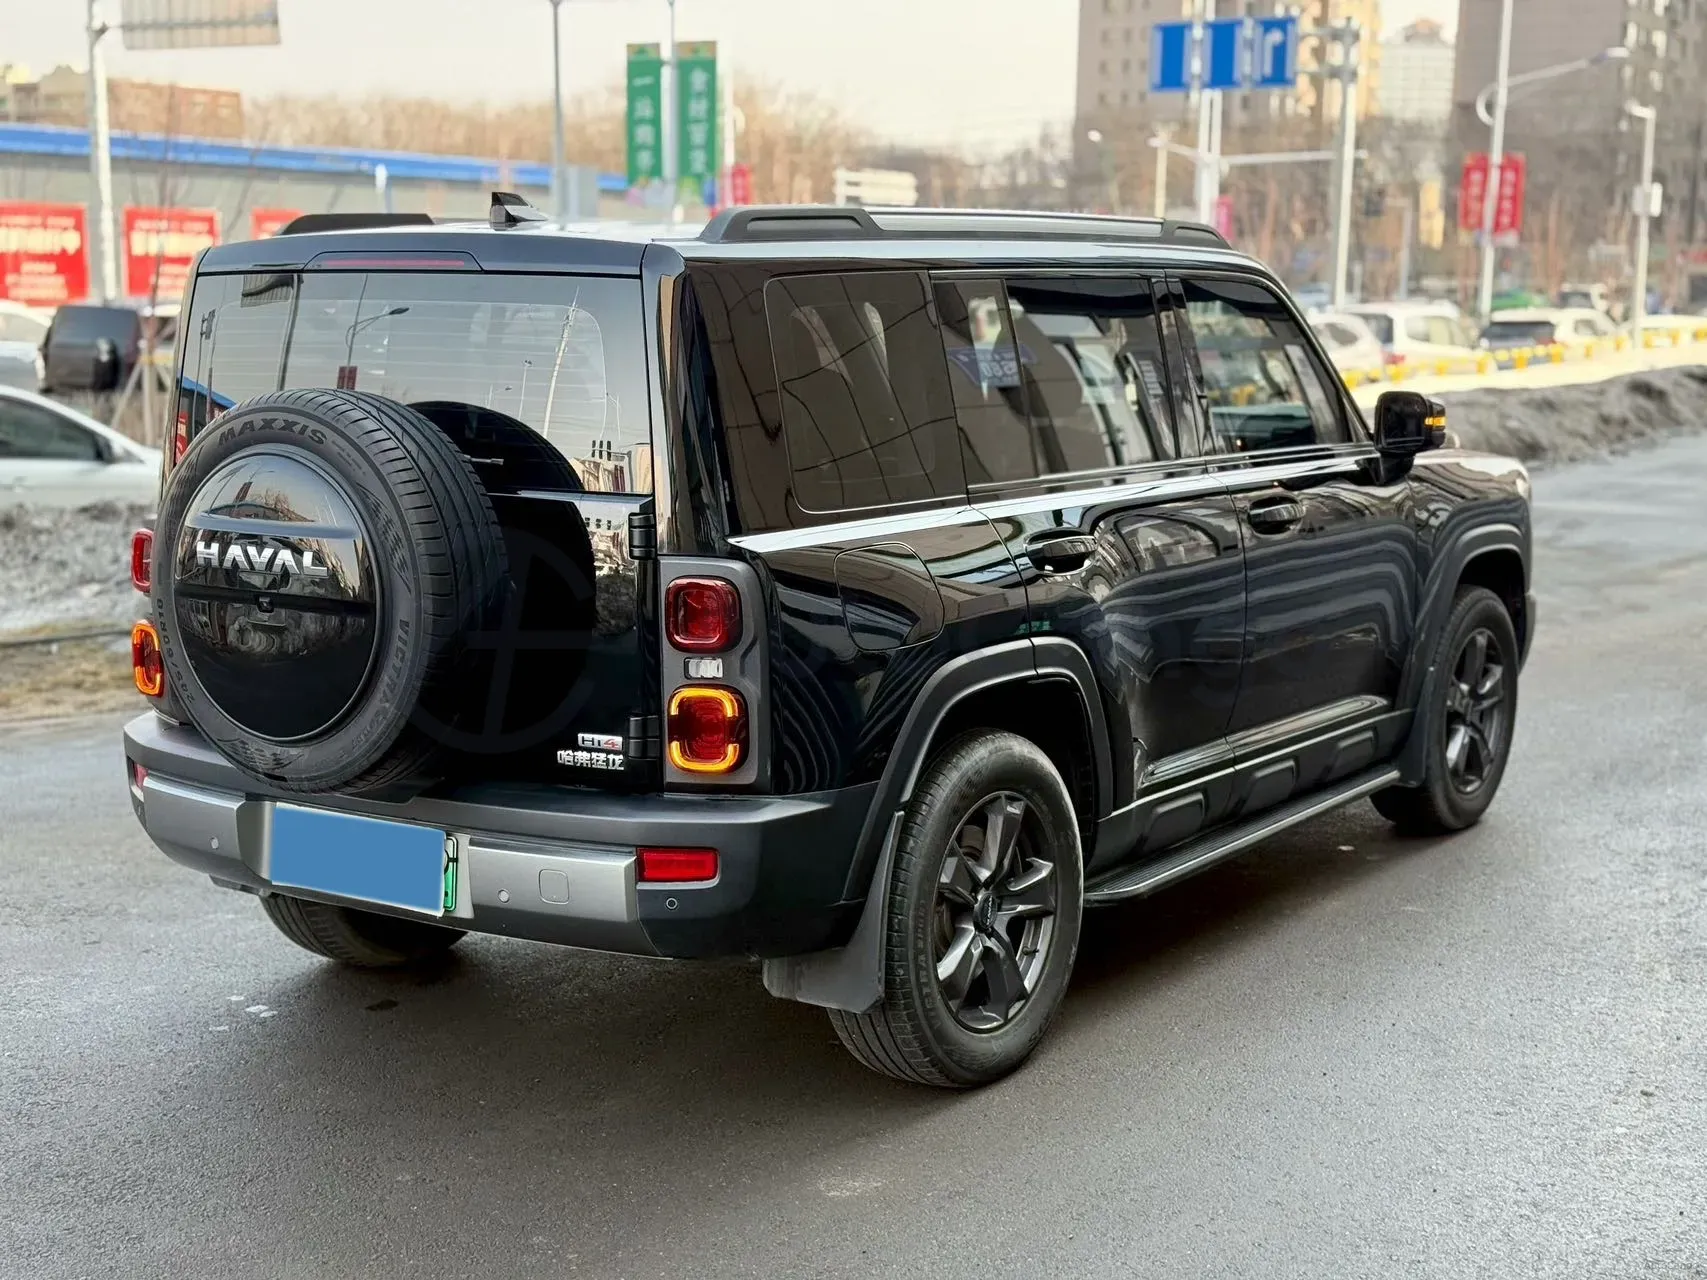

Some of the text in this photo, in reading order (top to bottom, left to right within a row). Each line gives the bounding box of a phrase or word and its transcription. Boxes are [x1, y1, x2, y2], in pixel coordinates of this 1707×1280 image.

[217, 417, 327, 446] MAXXIS
[196, 541, 329, 577] HAVAL
[379, 618, 410, 705] VICTRA
[557, 749, 625, 771] 哈弗猛龙
